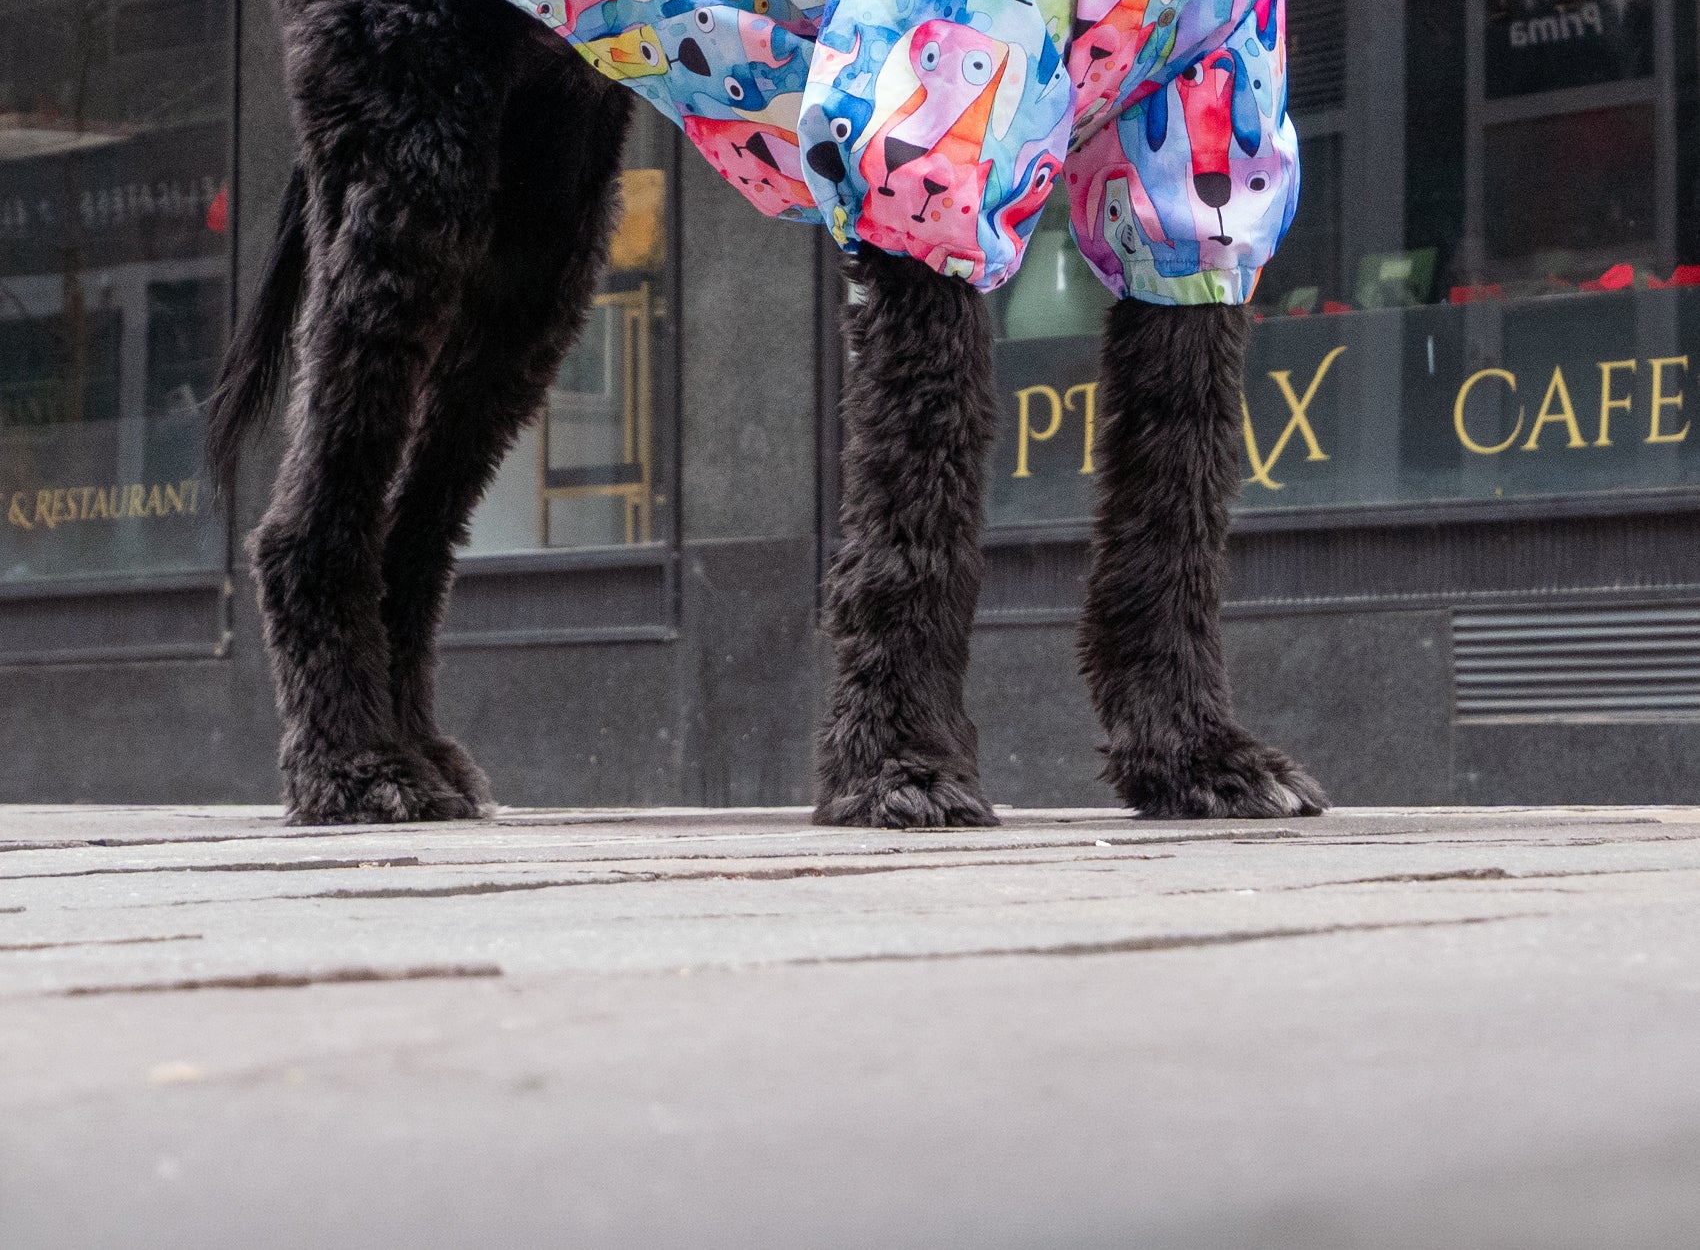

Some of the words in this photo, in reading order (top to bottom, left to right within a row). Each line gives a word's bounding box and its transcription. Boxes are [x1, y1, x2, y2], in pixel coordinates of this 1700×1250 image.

[1452, 354, 1691, 455] CAFE
[8, 491, 34, 530] &
[34, 480, 200, 529] RESTAURANT
